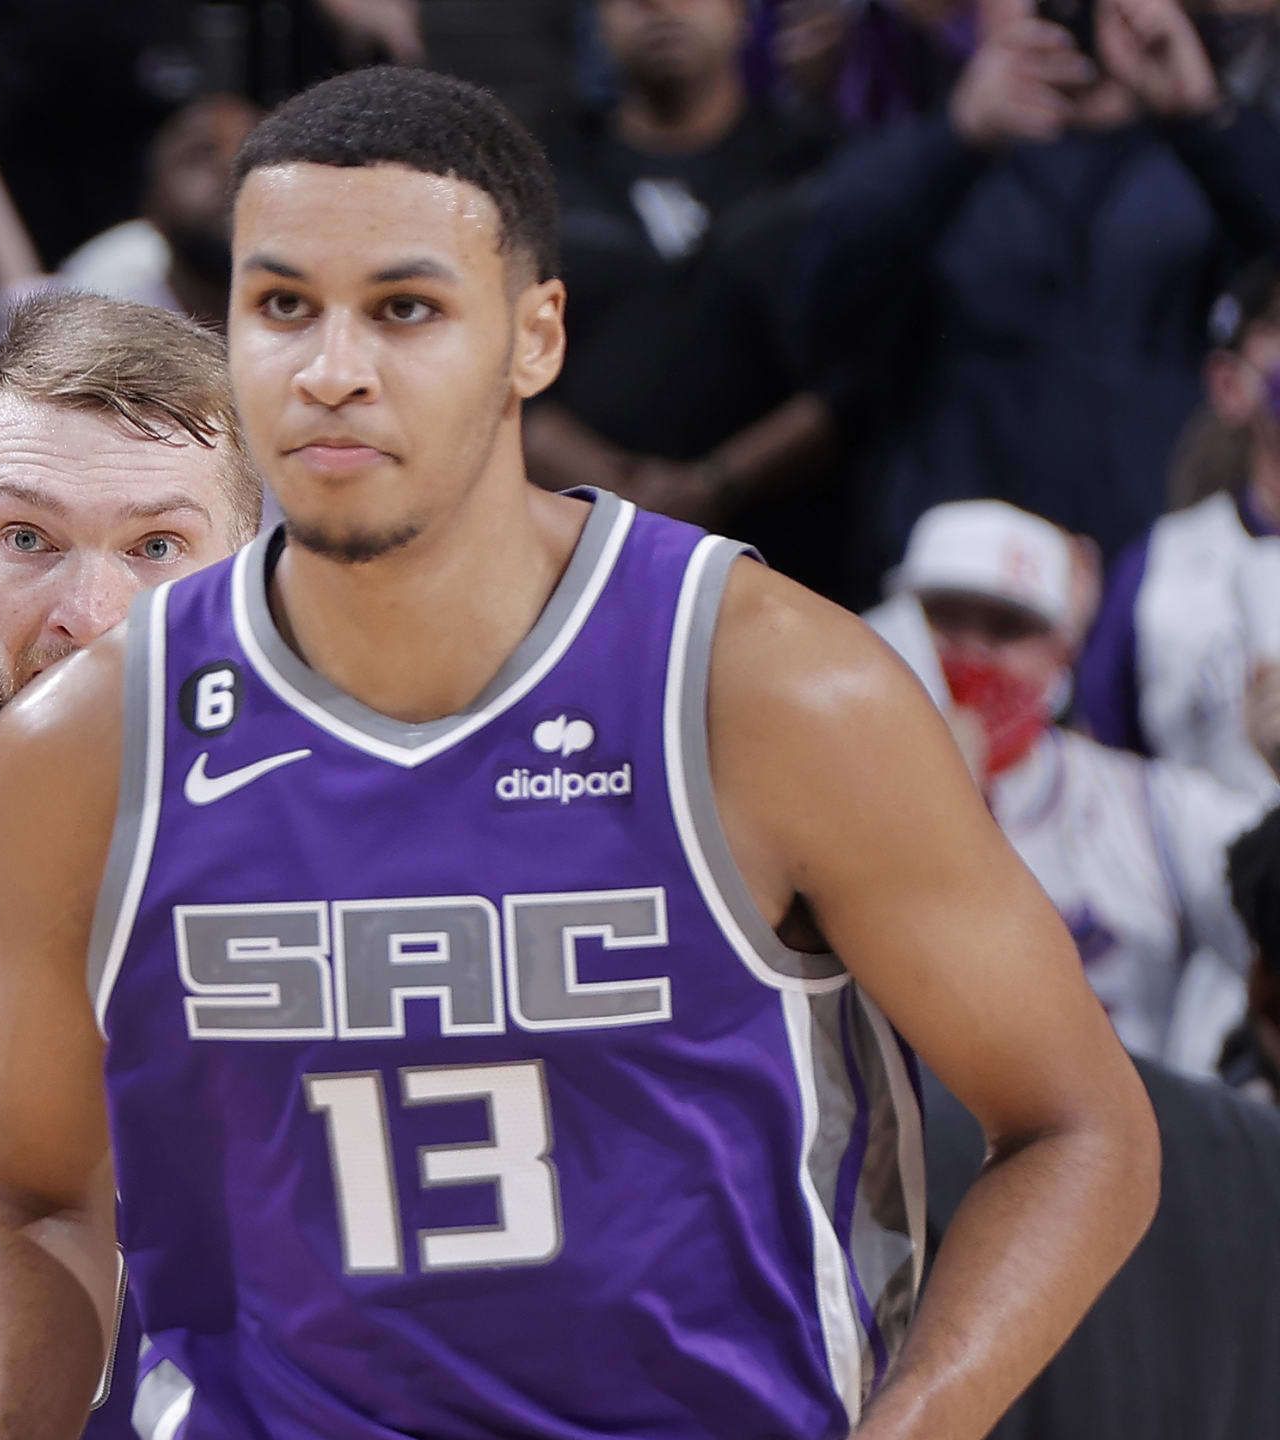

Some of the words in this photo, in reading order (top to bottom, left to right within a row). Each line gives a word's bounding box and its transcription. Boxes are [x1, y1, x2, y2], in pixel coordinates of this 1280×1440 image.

[195, 669, 234, 730] 6
[496, 763, 632, 805] dialpad
[173, 887, 672, 1040] SAC
[302, 1059, 565, 1276] 13
